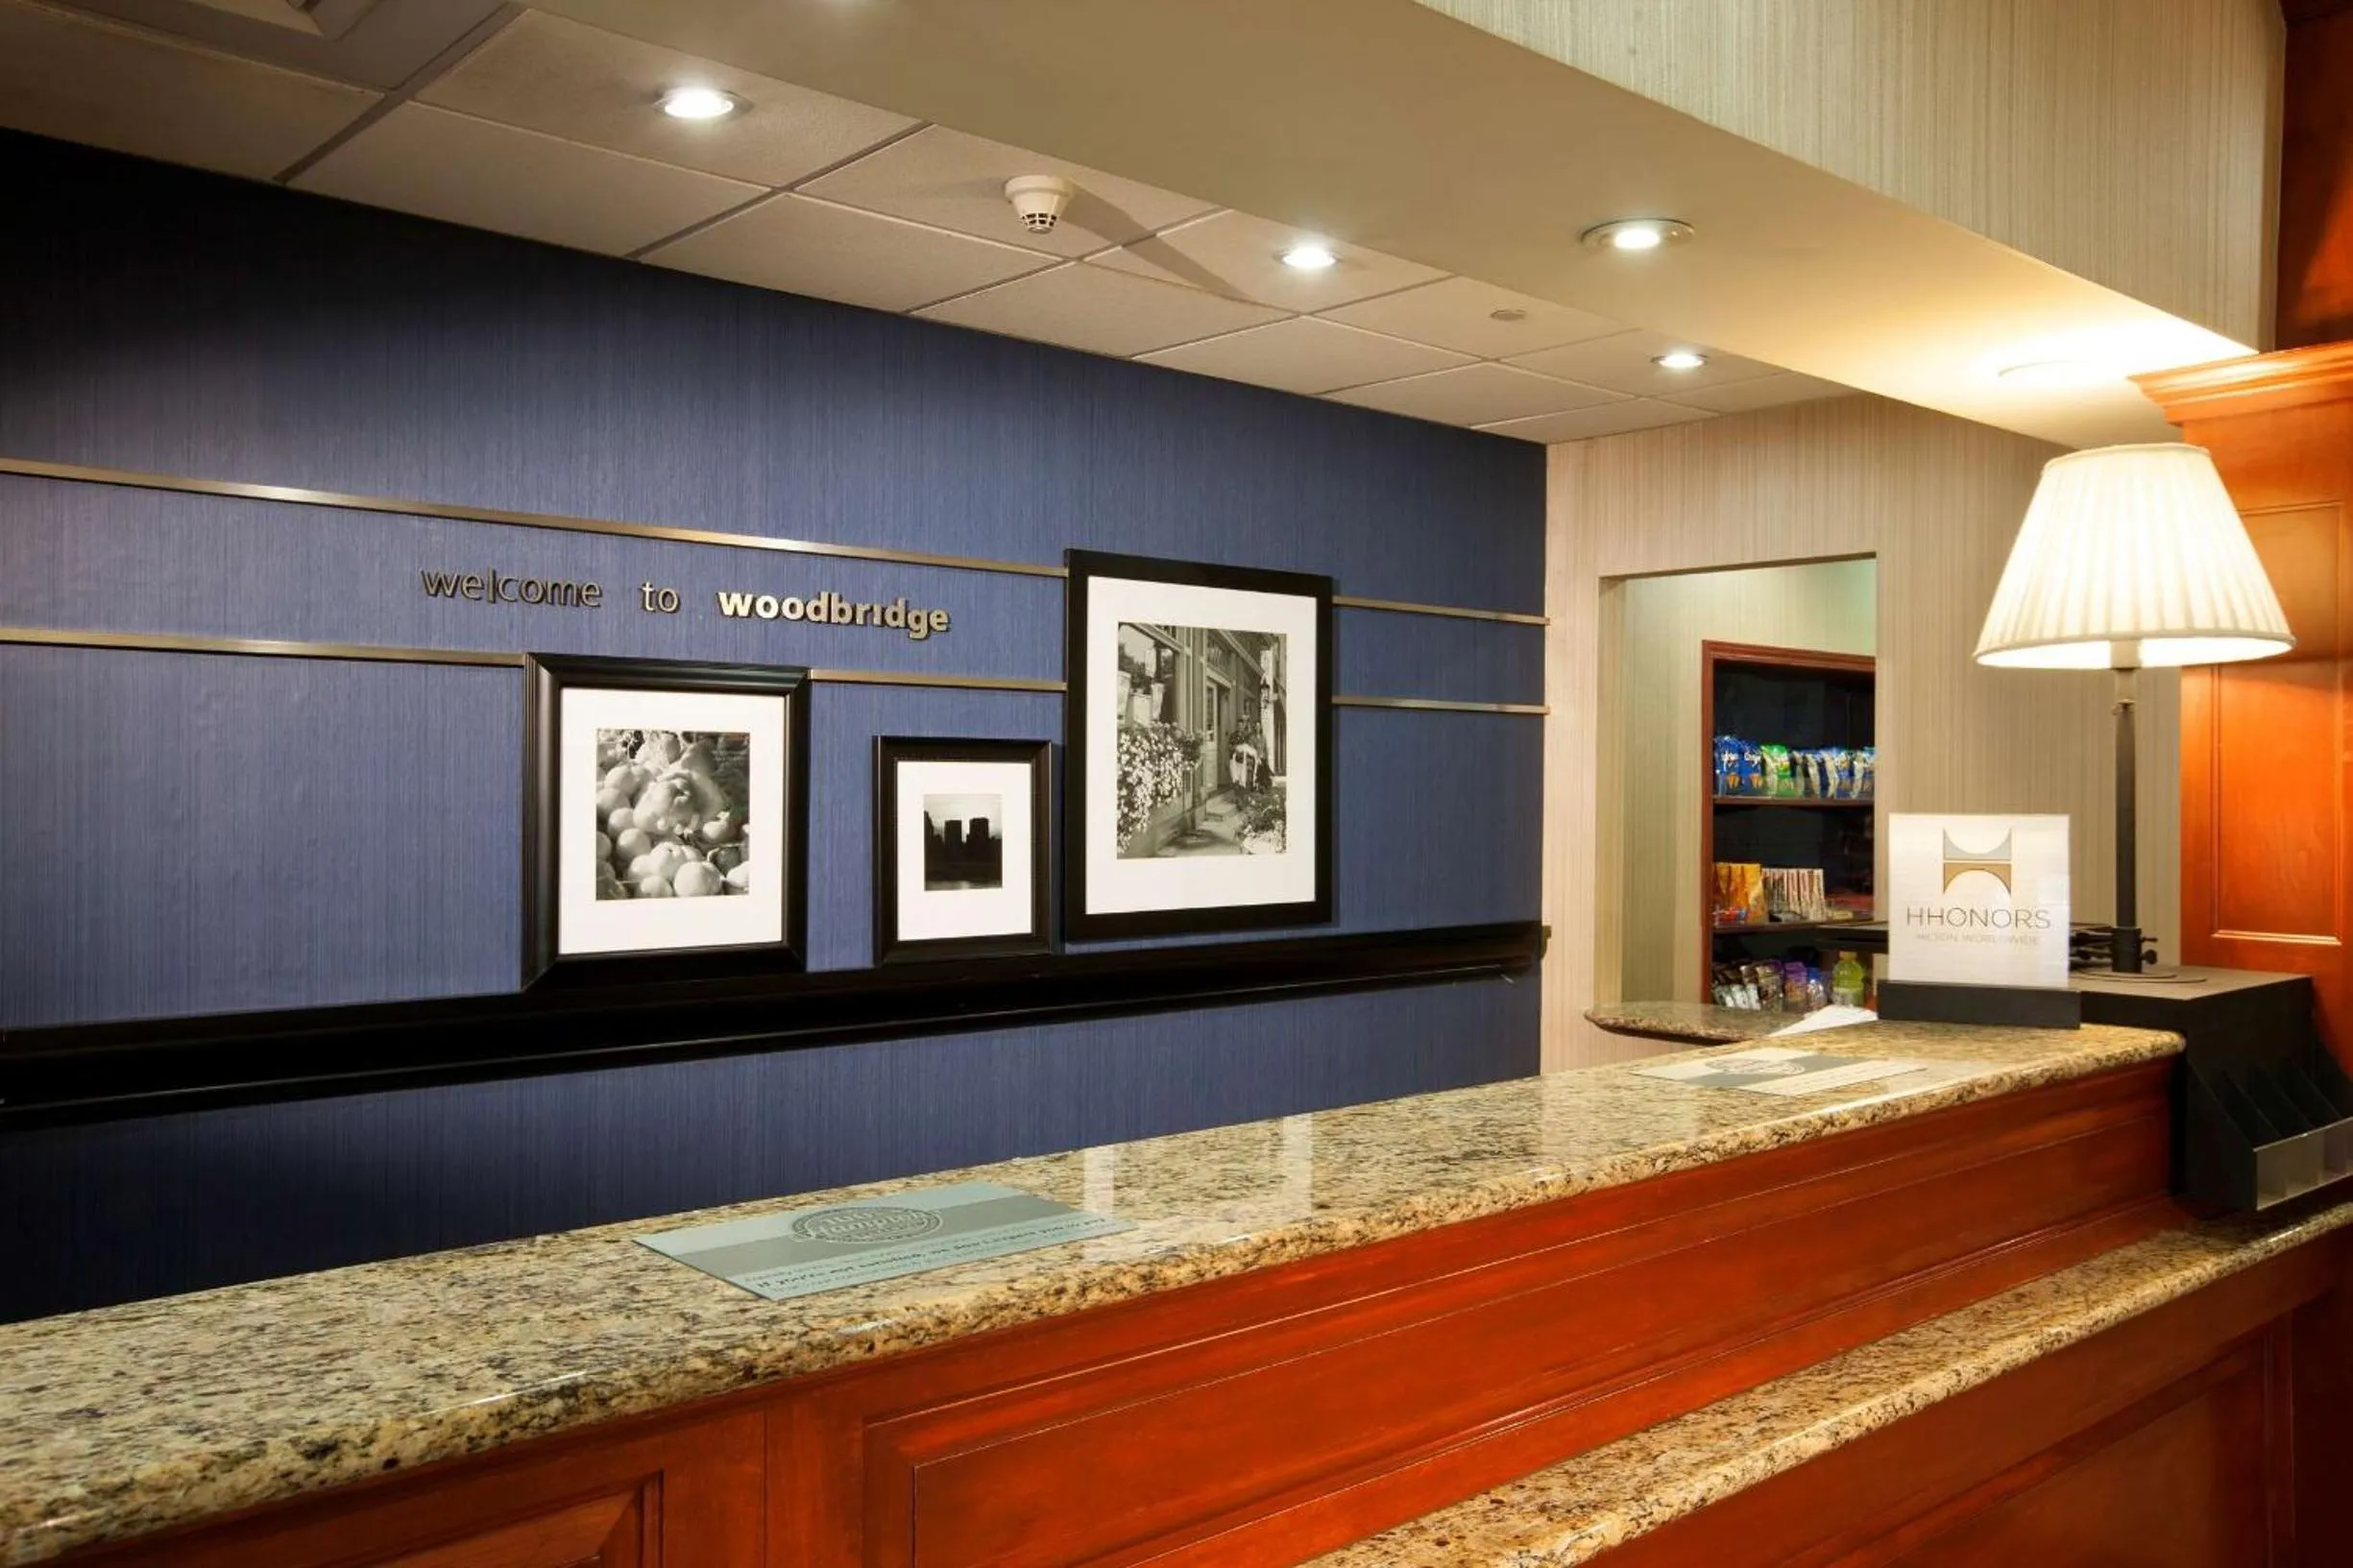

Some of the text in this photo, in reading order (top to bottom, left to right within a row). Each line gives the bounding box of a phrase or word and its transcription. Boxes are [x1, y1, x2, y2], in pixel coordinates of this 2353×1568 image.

[421, 568, 951, 640] welcome to woodbridge
[1906, 905, 2052, 929] HHONORS
